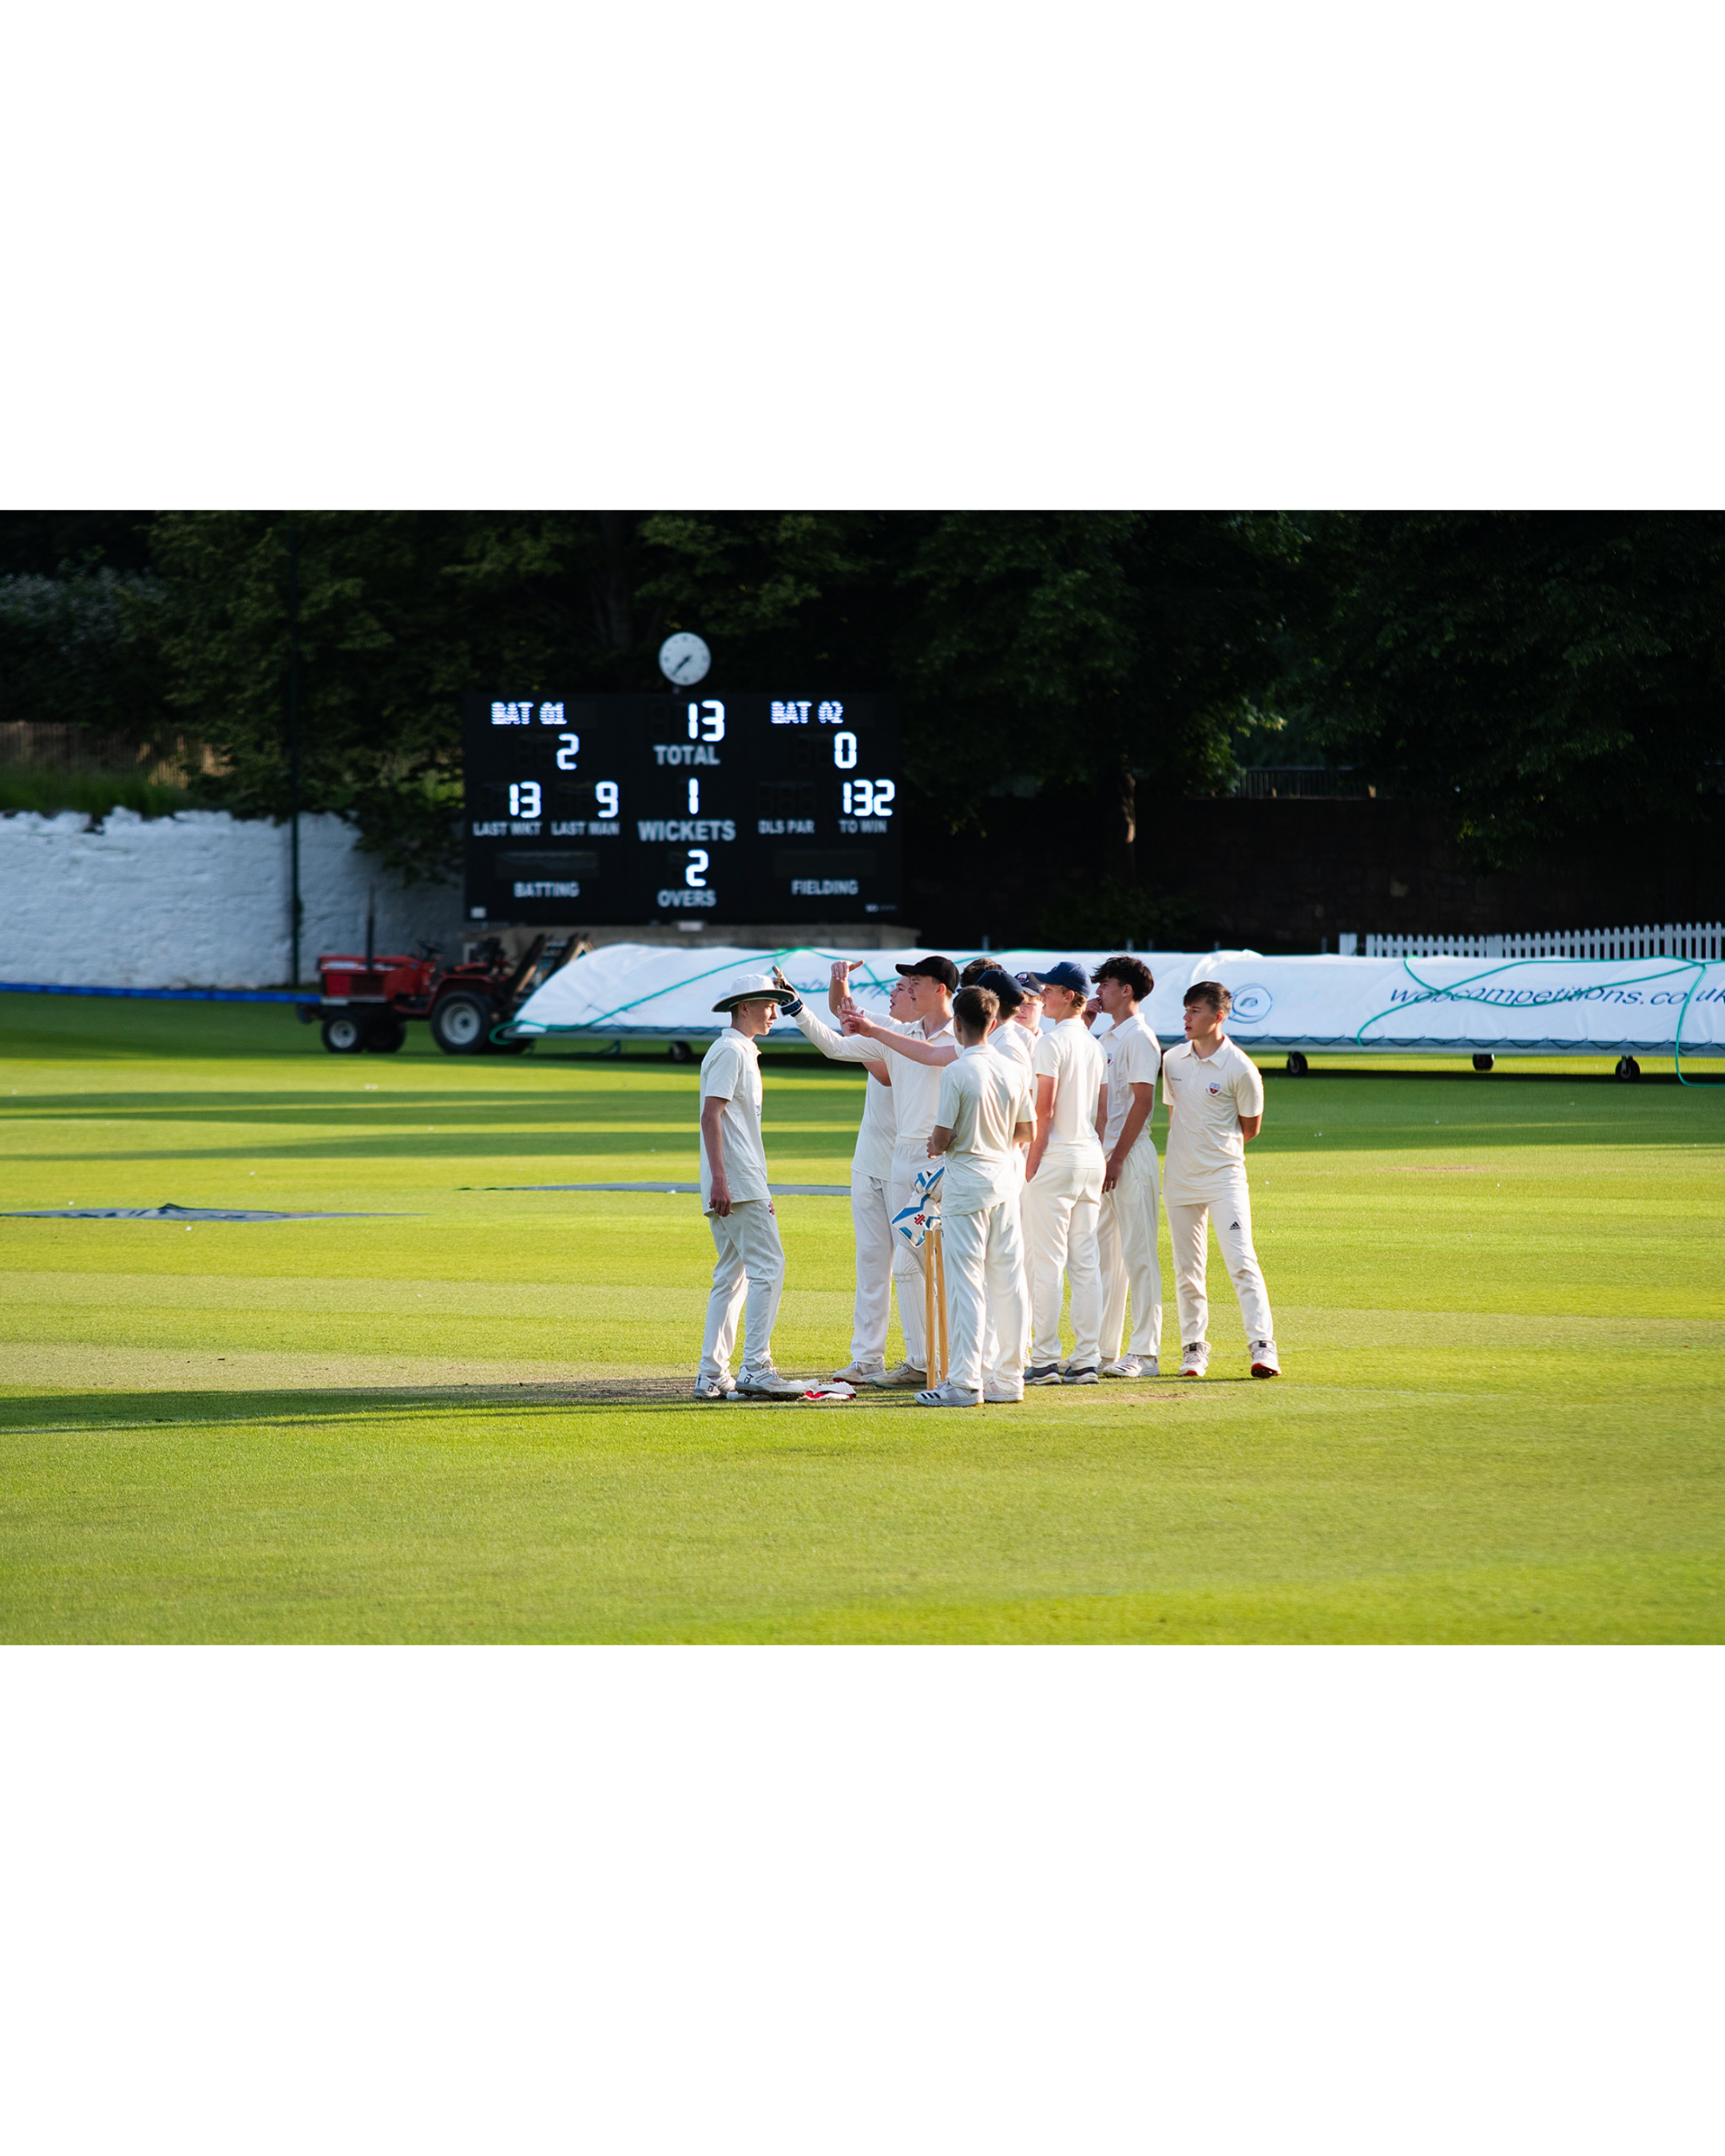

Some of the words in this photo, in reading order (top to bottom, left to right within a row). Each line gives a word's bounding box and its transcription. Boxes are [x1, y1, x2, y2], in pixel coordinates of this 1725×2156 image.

[491, 702, 533, 724] BAT
[688, 700, 724, 742] 13
[771, 701, 812, 723] BAT
[557, 734, 579, 770] 2
[654, 745, 720, 765] TOTAL
[835, 732, 857, 768] 0
[510, 782, 541, 818] 13
[596, 781, 618, 818] 9
[689, 779, 698, 814] 1
[843, 779, 894, 816] 132
[474, 822, 508, 836] LAST
[510, 822, 541, 834] WKT
[552, 822, 585, 835] LAST
[589, 822, 619, 835] MAN
[638, 820, 736, 841] WICKETS
[759, 820, 784, 834] DLS
[787, 820, 814, 833] PAR
[839, 819, 858, 833] TO
[860, 820, 886, 832] WIN
[686, 850, 708, 886] 2
[514, 882, 579, 897] BATTING
[792, 880, 858, 894] FIELDING
[658, 890, 716, 907] OVERS
